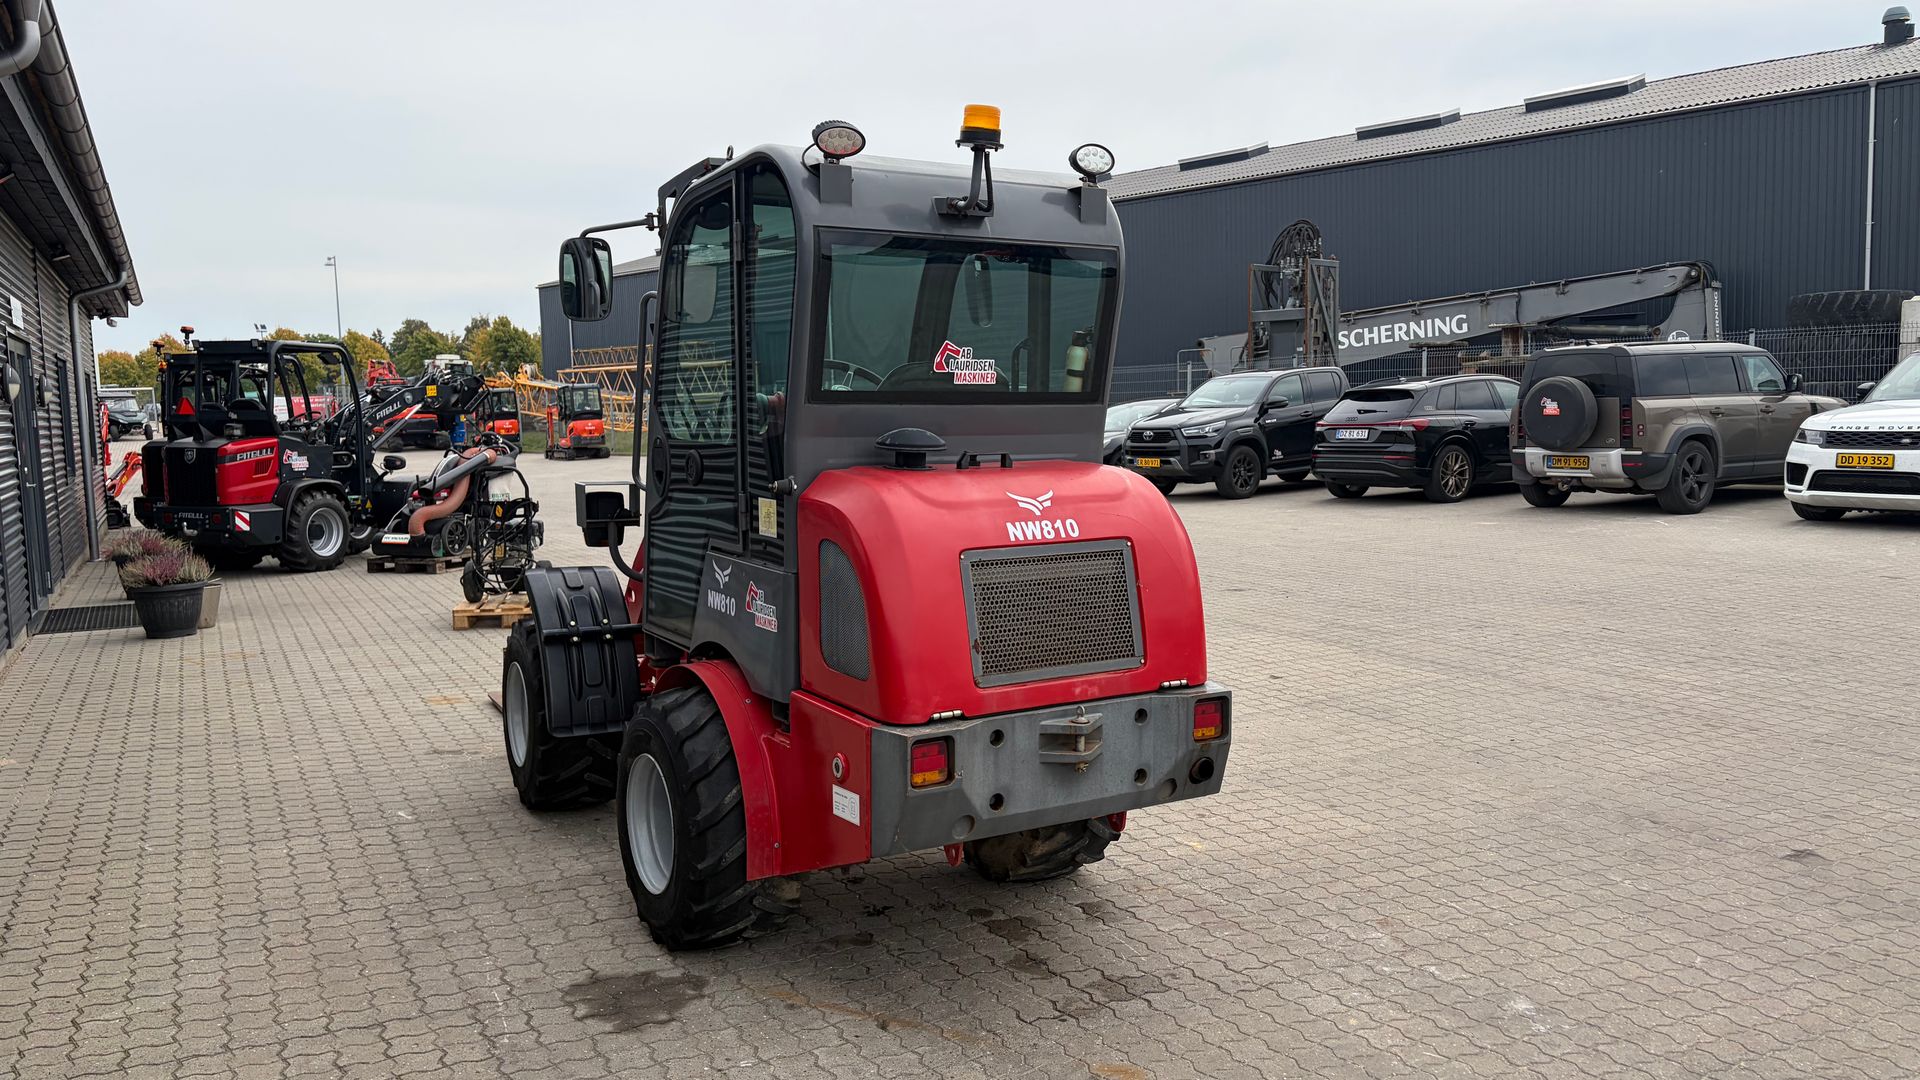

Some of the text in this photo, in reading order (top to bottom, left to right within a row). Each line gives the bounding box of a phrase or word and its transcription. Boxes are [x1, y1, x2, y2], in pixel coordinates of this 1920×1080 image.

[1337, 314, 1468, 350] SCHERNING
[960, 348, 972, 359] AB
[949, 360, 994, 371] LAURIDSEN
[954, 372, 996, 383] MASKINER
[375, 401, 402, 420] PITBULL
[1356, 430, 1366, 438] 631
[236, 448, 273, 461] PITBULL
[1840, 455, 1889, 466] DD 19 352
[1552, 456, 1587, 467] DM 91 956
[1005, 518, 1080, 542] NW810
[707, 588, 736, 617] NW810
[755, 614, 777, 632] MASKINER
